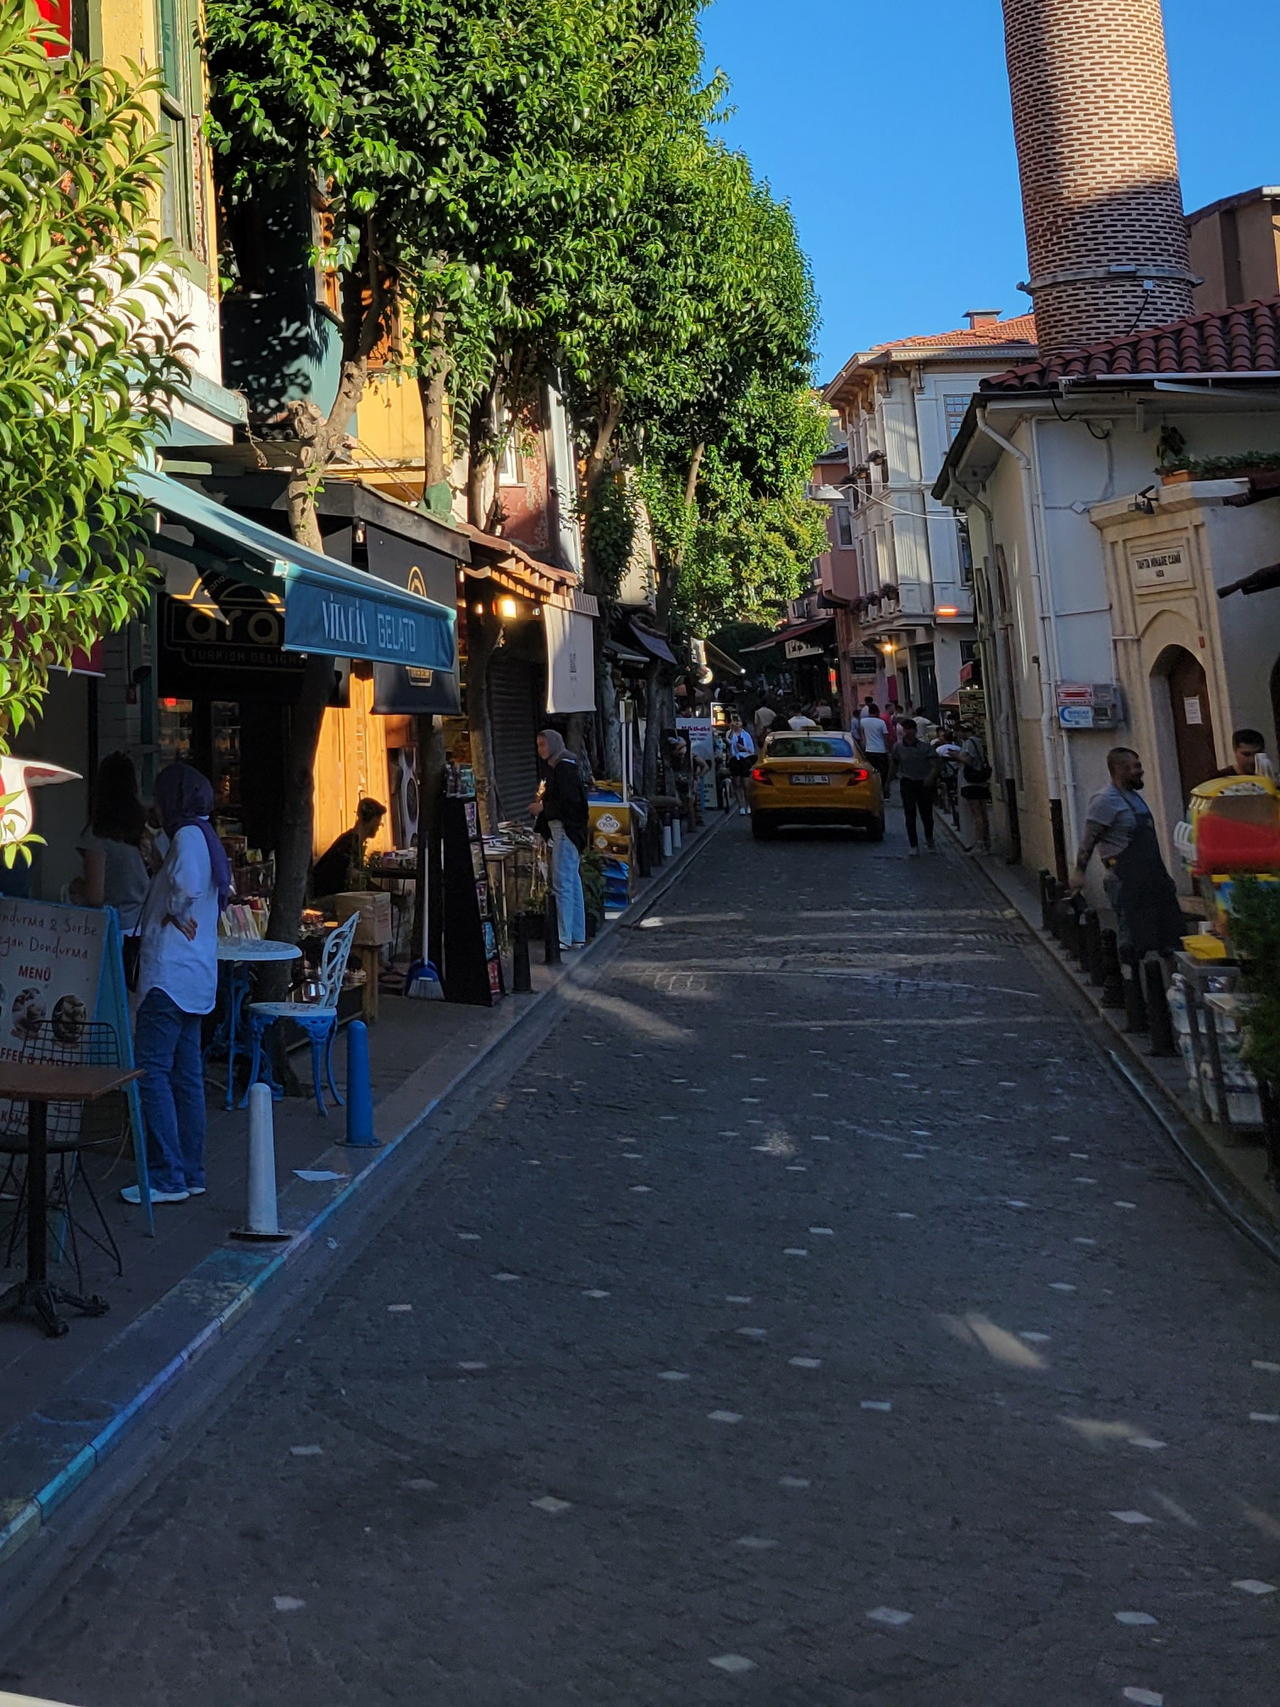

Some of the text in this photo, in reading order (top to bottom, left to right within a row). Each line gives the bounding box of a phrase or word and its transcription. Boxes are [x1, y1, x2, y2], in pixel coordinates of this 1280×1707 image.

[185, 607, 280, 646] ara
[377, 612, 416, 652] GELATO
[191, 649, 303, 665] TURKISH DELIGHT
[18, 964, 52, 982] MENÜ
